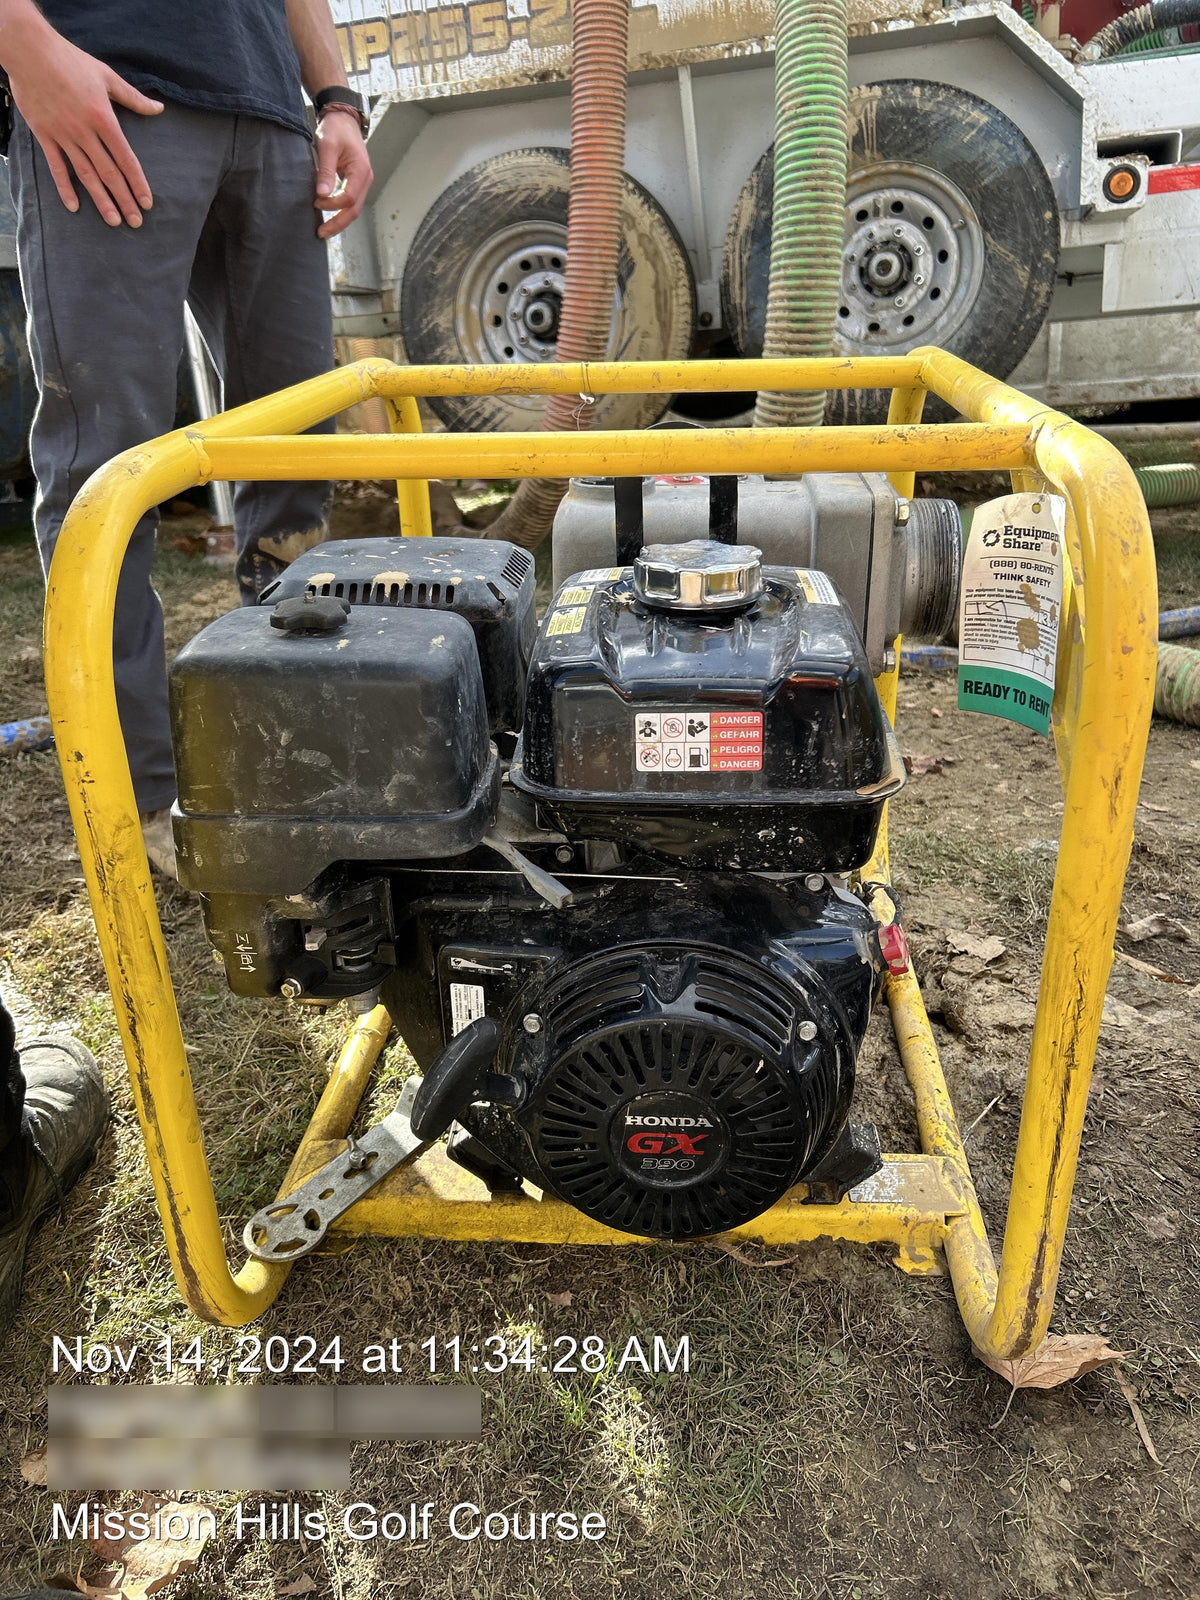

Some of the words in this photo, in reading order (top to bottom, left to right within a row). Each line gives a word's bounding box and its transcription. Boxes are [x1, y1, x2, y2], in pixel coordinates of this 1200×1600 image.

[1003, 525, 1060, 543] Equipmen
[1003, 538, 1041, 551] Share
[989, 560, 1018, 569] (888)
[1020, 561, 1055, 576] 80-RENTS
[993, 573, 1024, 582] THINK
[1025, 575, 1052, 588] SAFETY
[963, 680, 1010, 700] READY
[1012, 688, 1027, 706] TO
[1028, 694, 1051, 718] RENT
[720, 716, 761, 724] DANGER
[719, 730, 760, 739] GEFAHR
[719, 745, 761, 754] PELIGRO
[719, 760, 760, 768] DANGER
[625, 1115, 714, 1128] HONDA
[626, 1132, 710, 1155] GX
[640, 1157, 696, 1171] 390
